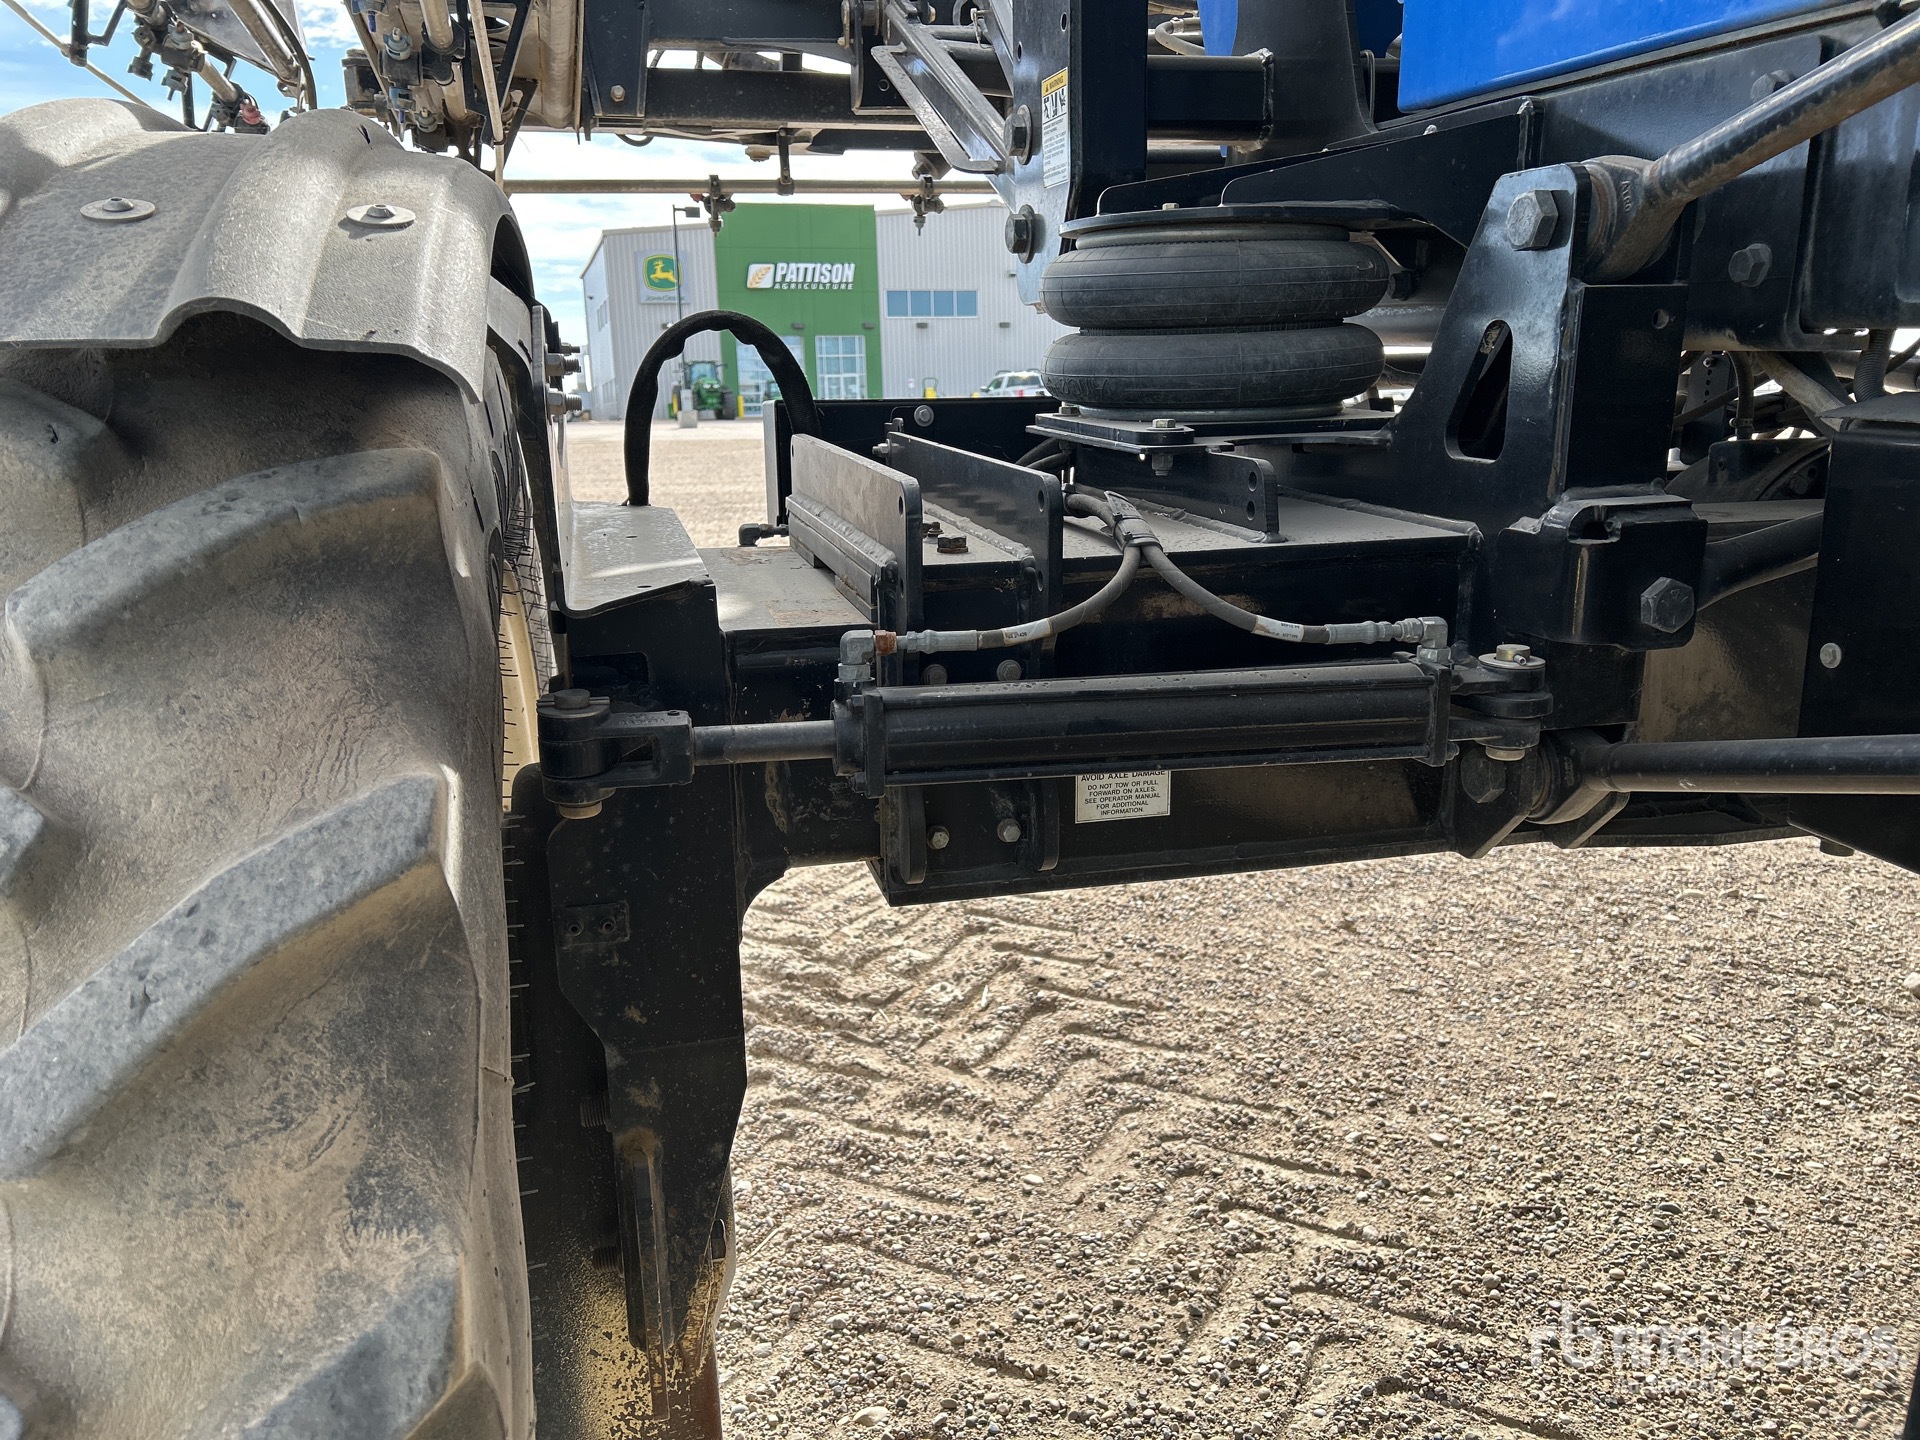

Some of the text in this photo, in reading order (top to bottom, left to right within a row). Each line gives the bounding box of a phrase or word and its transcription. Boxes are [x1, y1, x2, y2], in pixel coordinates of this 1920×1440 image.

[774, 262, 856, 284] PATTISON
[1080, 774, 1105, 782] AVOID
[1089, 789, 1121, 797] FORWARD
[1099, 795, 1133, 803] OPERATOR
[1135, 792, 1161, 800] MANUAL
[1112, 800, 1149, 808] ADDITIONAL
